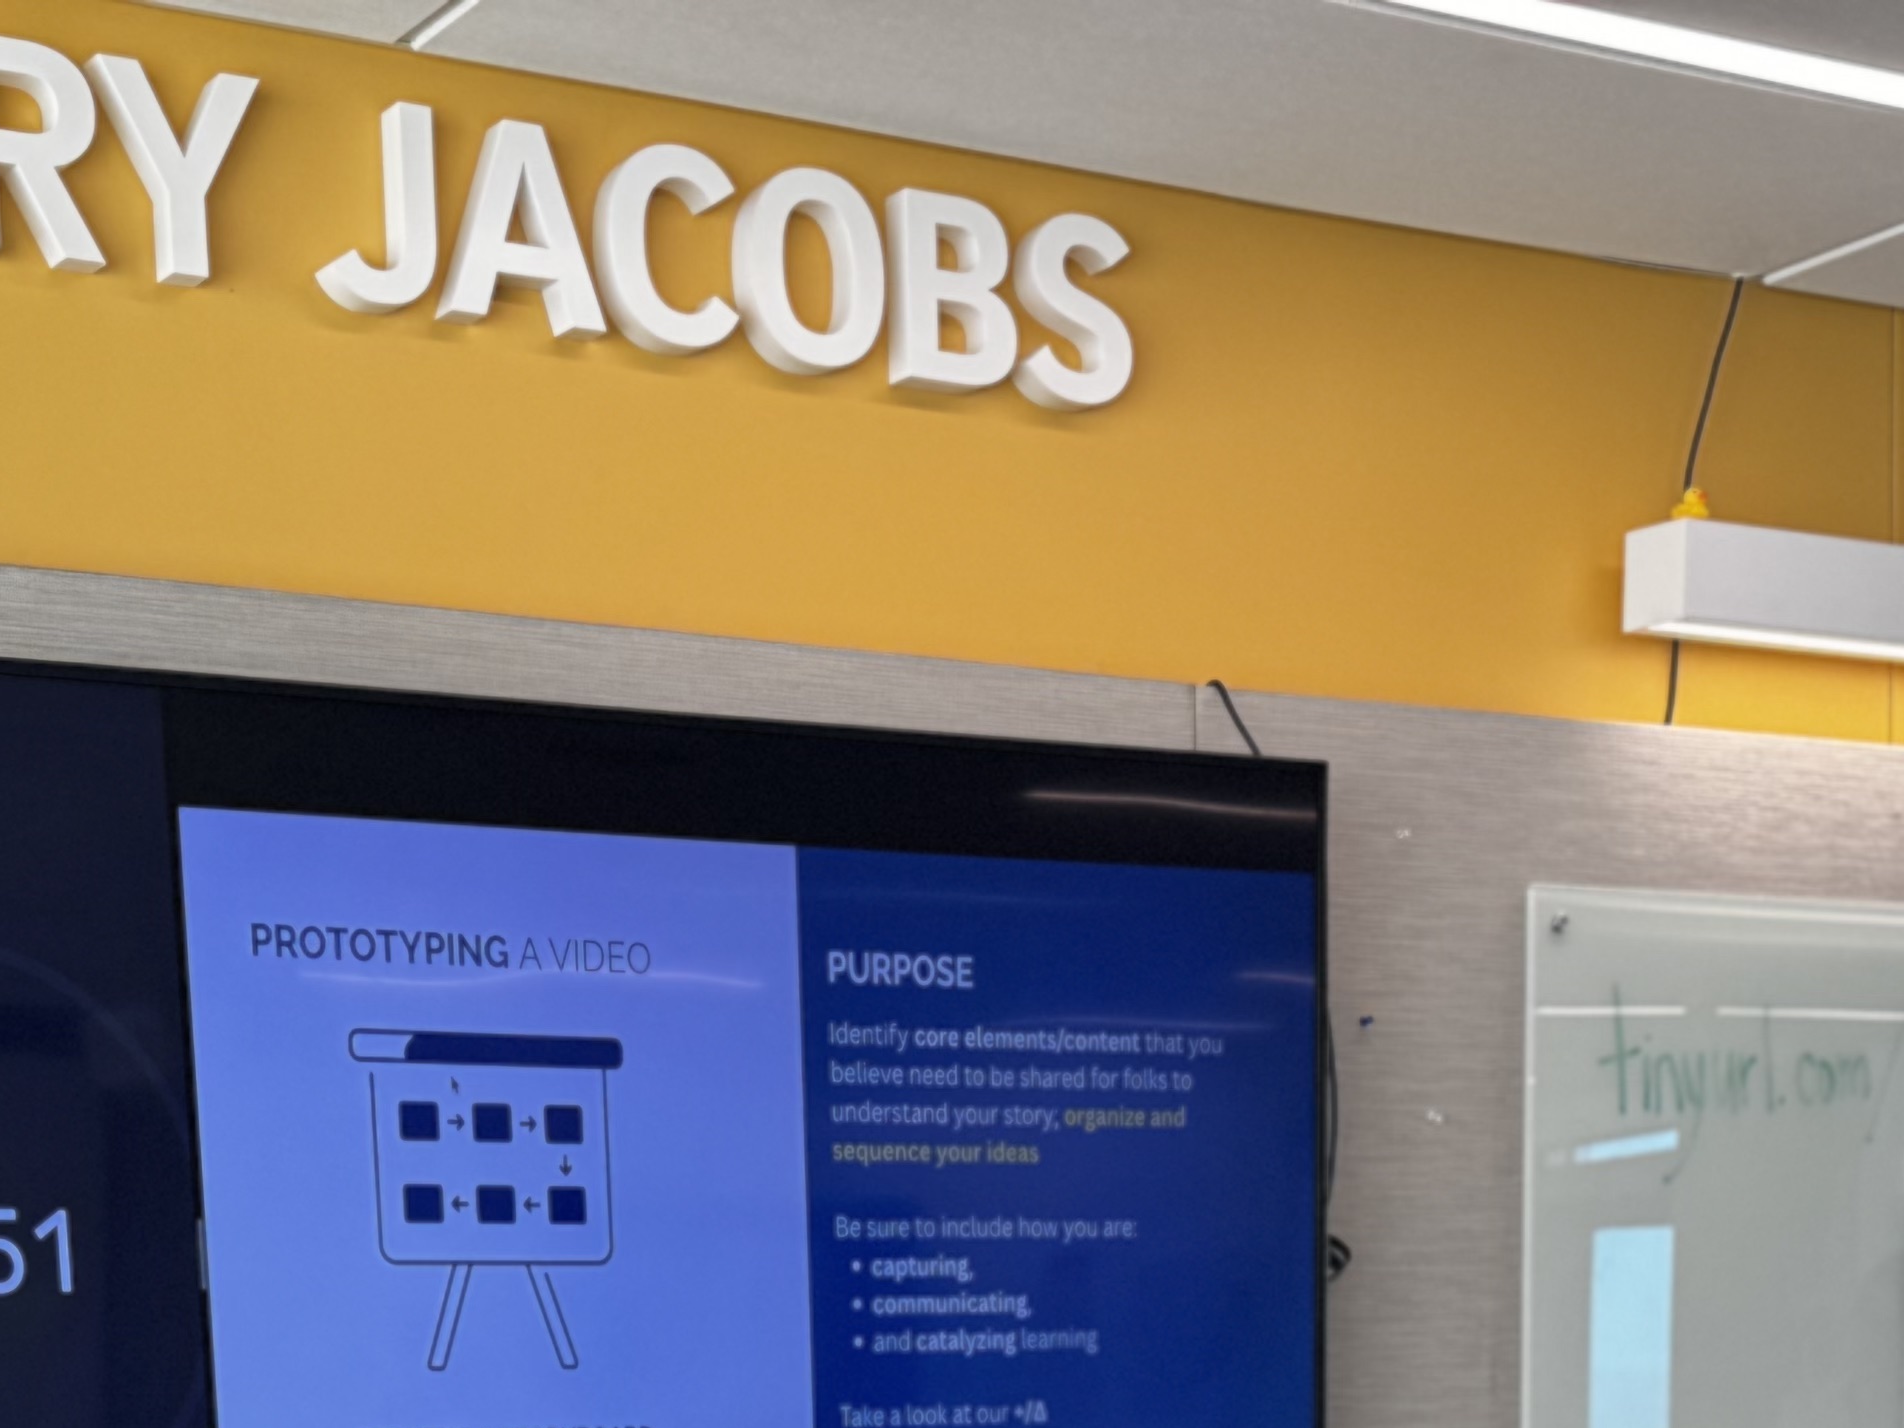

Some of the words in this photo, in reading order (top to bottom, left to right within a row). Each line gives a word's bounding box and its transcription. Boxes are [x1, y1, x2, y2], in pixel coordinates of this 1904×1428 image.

[314, 101, 1133, 413] JACOBS
[250, 922, 508, 971] PROTOTYPING
[519, 937, 543, 972] A
[550, 938, 651, 975] VIDEO
[828, 951, 975, 988] PURPOSE
[829, 1022, 908, 1051] Identify
[915, 1030, 958, 1049] core
[964, 1026, 1141, 1055] elements/content
[1145, 1034, 1183, 1055] that
[1188, 1036, 1223, 1058] you
[831, 1062, 903, 1085] believe
[910, 1063, 958, 1087] need
[964, 1066, 983, 1087] to
[990, 1066, 1015, 1088] be
[1020, 1067, 1085, 1089] shared
[1091, 1069, 1118, 1090] for
[1123, 1070, 1166, 1091] folks
[1173, 1072, 1192, 1091] to
[832, 1102, 948, 1125] understand
[953, 1106, 997, 1130] your
[1064, 1109, 1145, 1131] organize
[1150, 1107, 1186, 1128] and
[832, 1141, 930, 1165] sequence
[935, 1143, 981, 1167] your
[987, 1141, 1039, 1164] ideas
[836, 1216, 861, 1238] Be
[867, 1221, 910, 1238] sure
[915, 1219, 936, 1238] to
[941, 1217, 1013, 1239] include
[1018, 1217, 1057, 1238] how
[1063, 1220, 1098, 1242] you
[1103, 1221, 1137, 1238] are:
[871, 1256, 974, 1282] capturing,
[873, 1330, 911, 1352] and
[916, 1328, 1017, 1356] catalyzing
[840, 1406, 884, 1428] Take
[890, 1409, 902, 1427] a
[907, 1404, 948, 1426] look
[953, 1406, 972, 1425] at
[977, 1406, 1009, 1424] our
